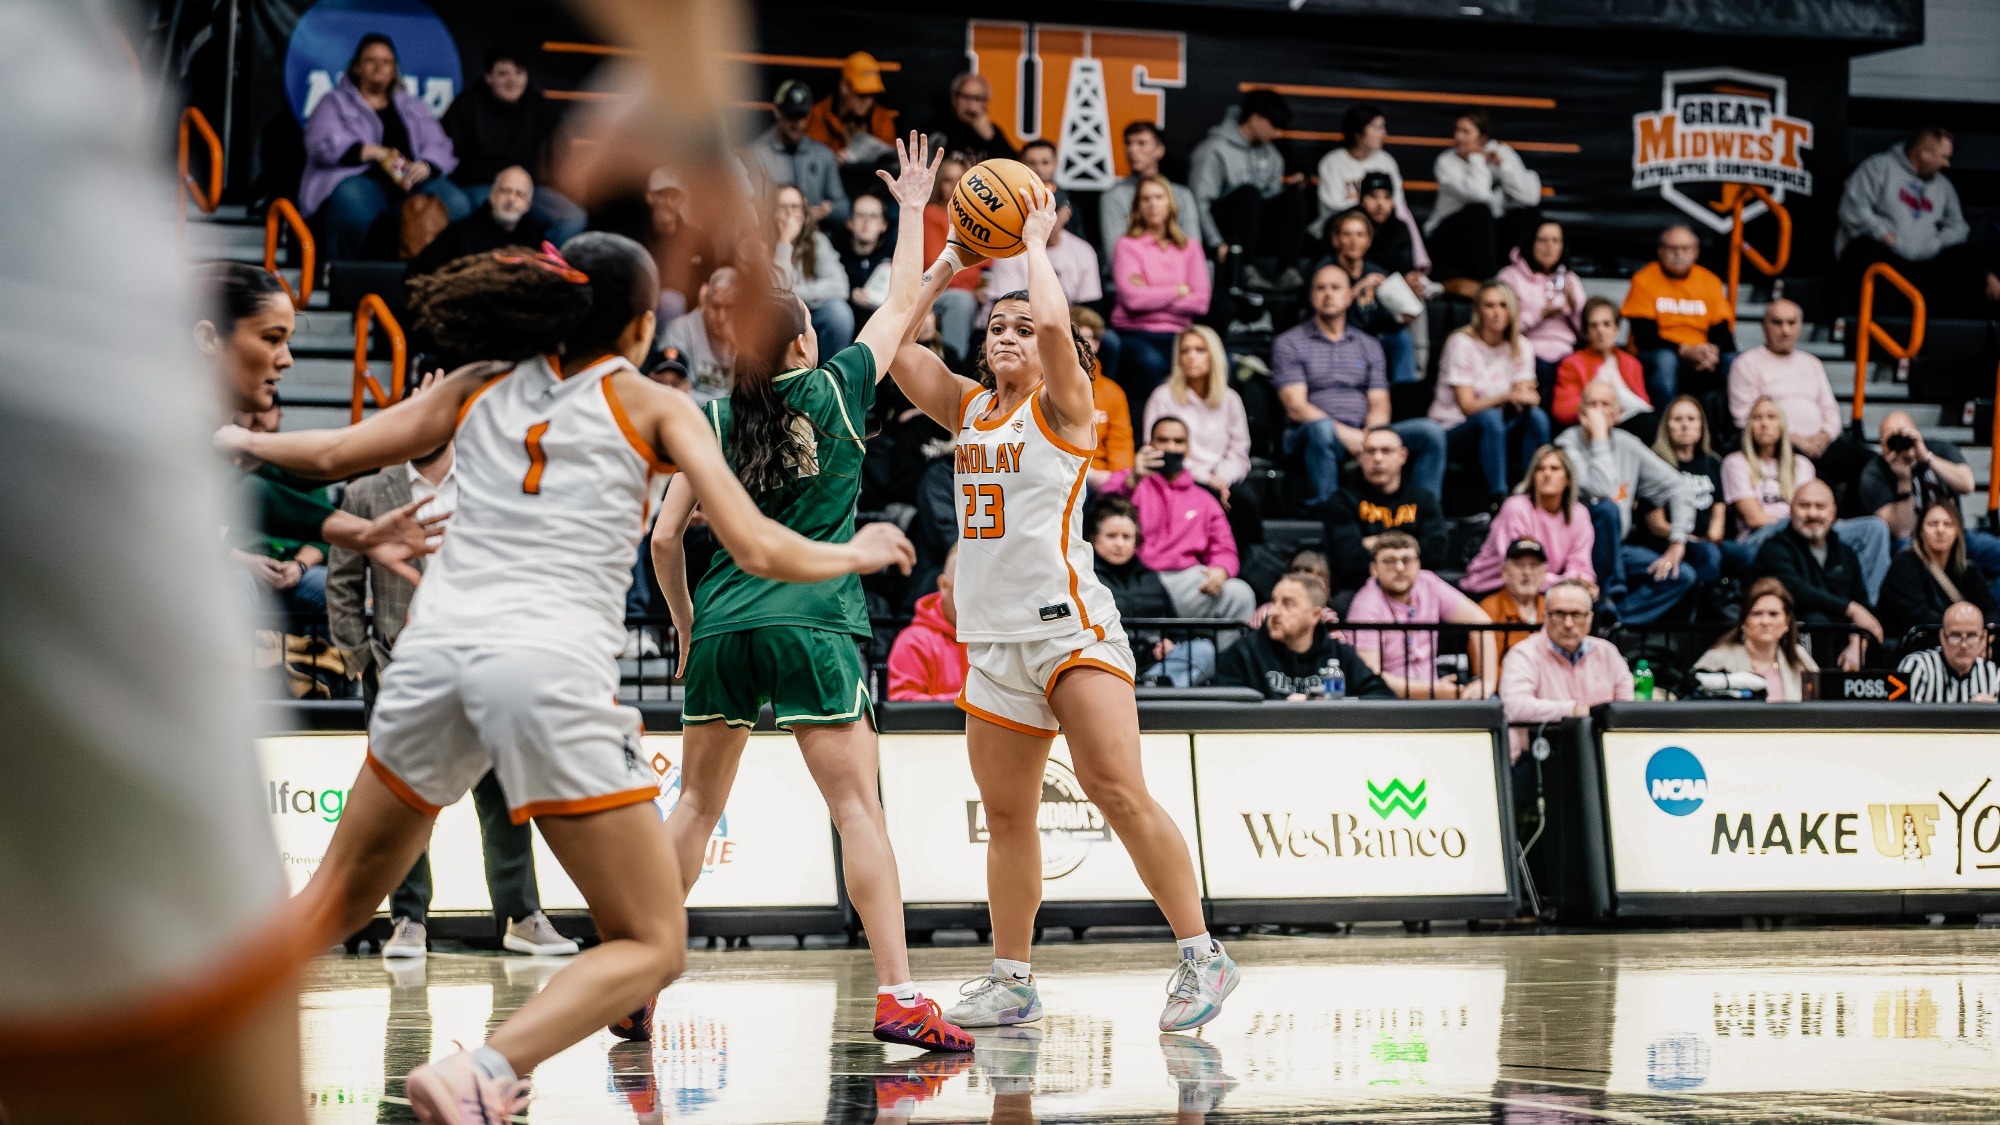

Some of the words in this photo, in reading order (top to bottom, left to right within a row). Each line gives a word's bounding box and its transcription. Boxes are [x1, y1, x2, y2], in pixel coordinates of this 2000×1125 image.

[1682, 101, 1766, 129] GREAT
[1638, 114, 1810, 170] MIDWEST
[966, 173, 1005, 213] NCAA
[952, 192, 992, 244] Wilson
[523, 419, 552, 496] 1
[954, 441, 1026, 475] INDLAY
[962, 483, 1006, 540] 23
[1843, 678, 1889, 699] POSS.
[1651, 778, 1708, 801] NCAA
[1240, 812, 1467, 859] WesBanco
[1711, 812, 1859, 855] MAKE
[1867, 803, 1941, 858] UF
[1938, 777, 2000, 875] YO
